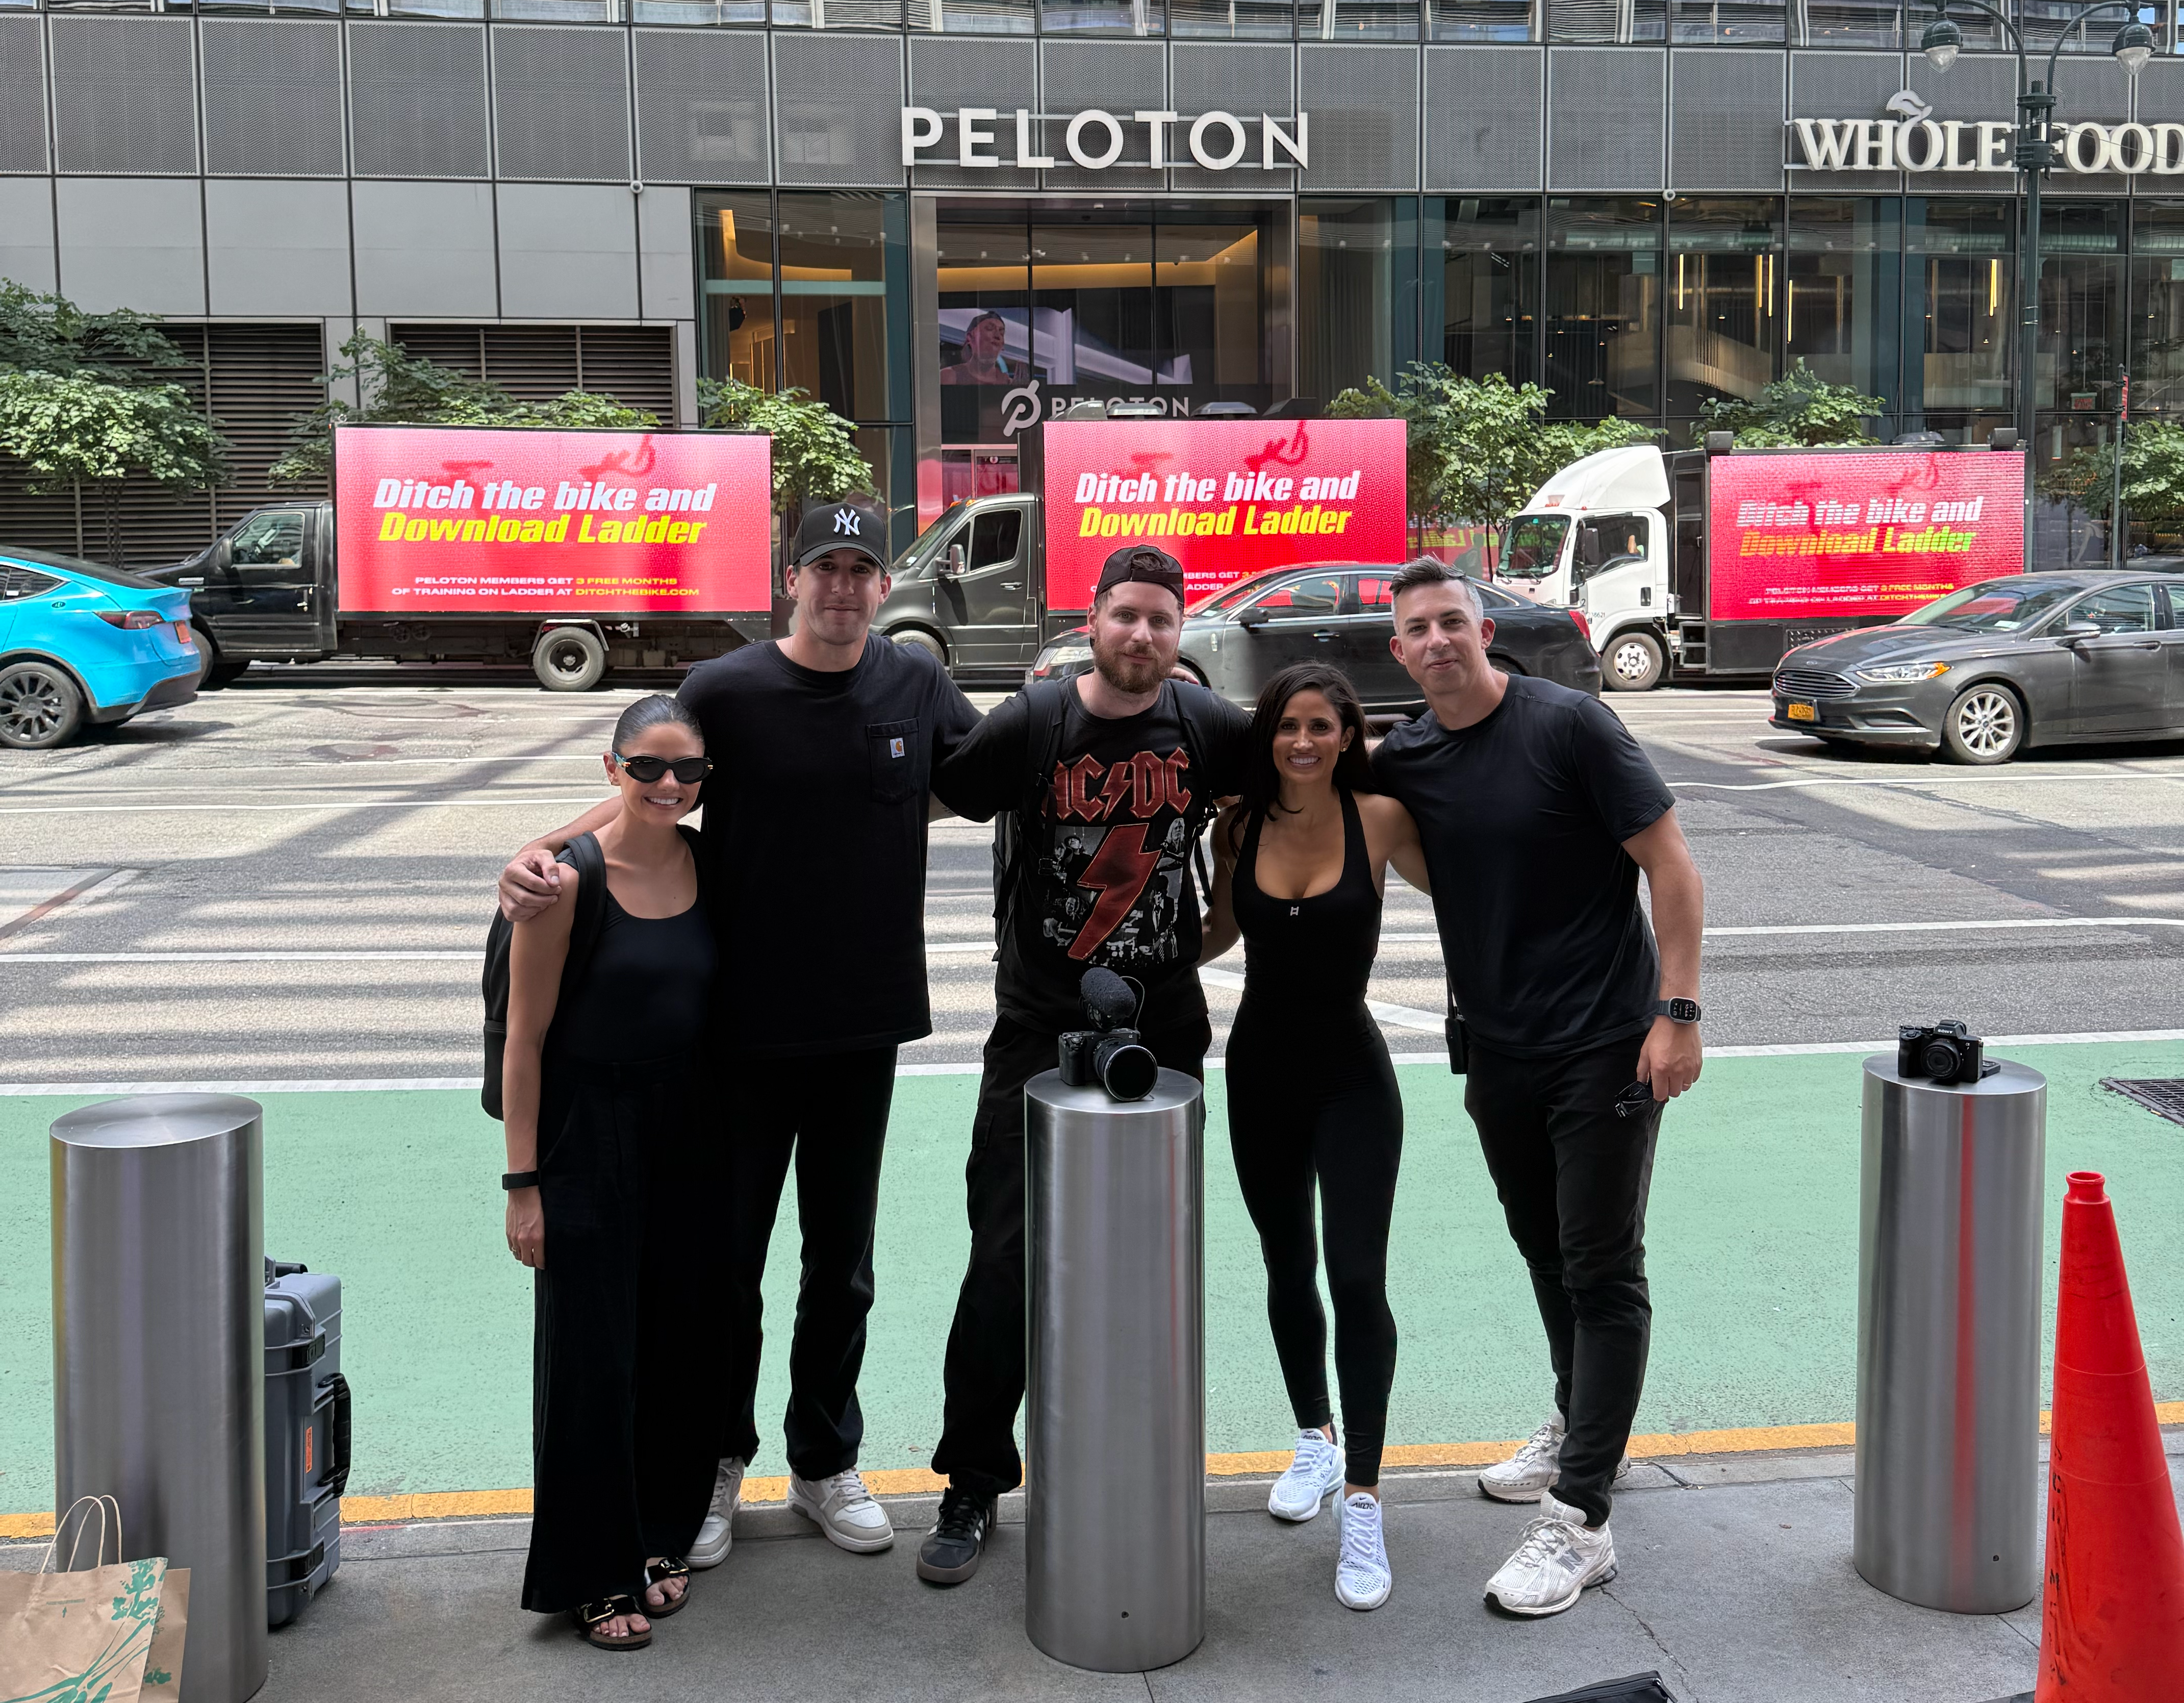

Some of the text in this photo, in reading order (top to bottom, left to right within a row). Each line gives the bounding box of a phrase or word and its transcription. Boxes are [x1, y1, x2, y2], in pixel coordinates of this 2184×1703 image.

[901, 107, 1308, 170] PELOTON
[1794, 118, 2013, 172] WHOLE
[373, 479, 717, 512] Ditch the bike and
[1075, 470, 1361, 504] Ditch the bike and
[833, 508, 860, 536] NY
[1079, 504, 1353, 537] Download Ladder
[1737, 495, 1985, 527] Ditch the bike and
[379, 512, 707, 544] Download Ladder
[1739, 526, 1976, 557] Download Ladder
